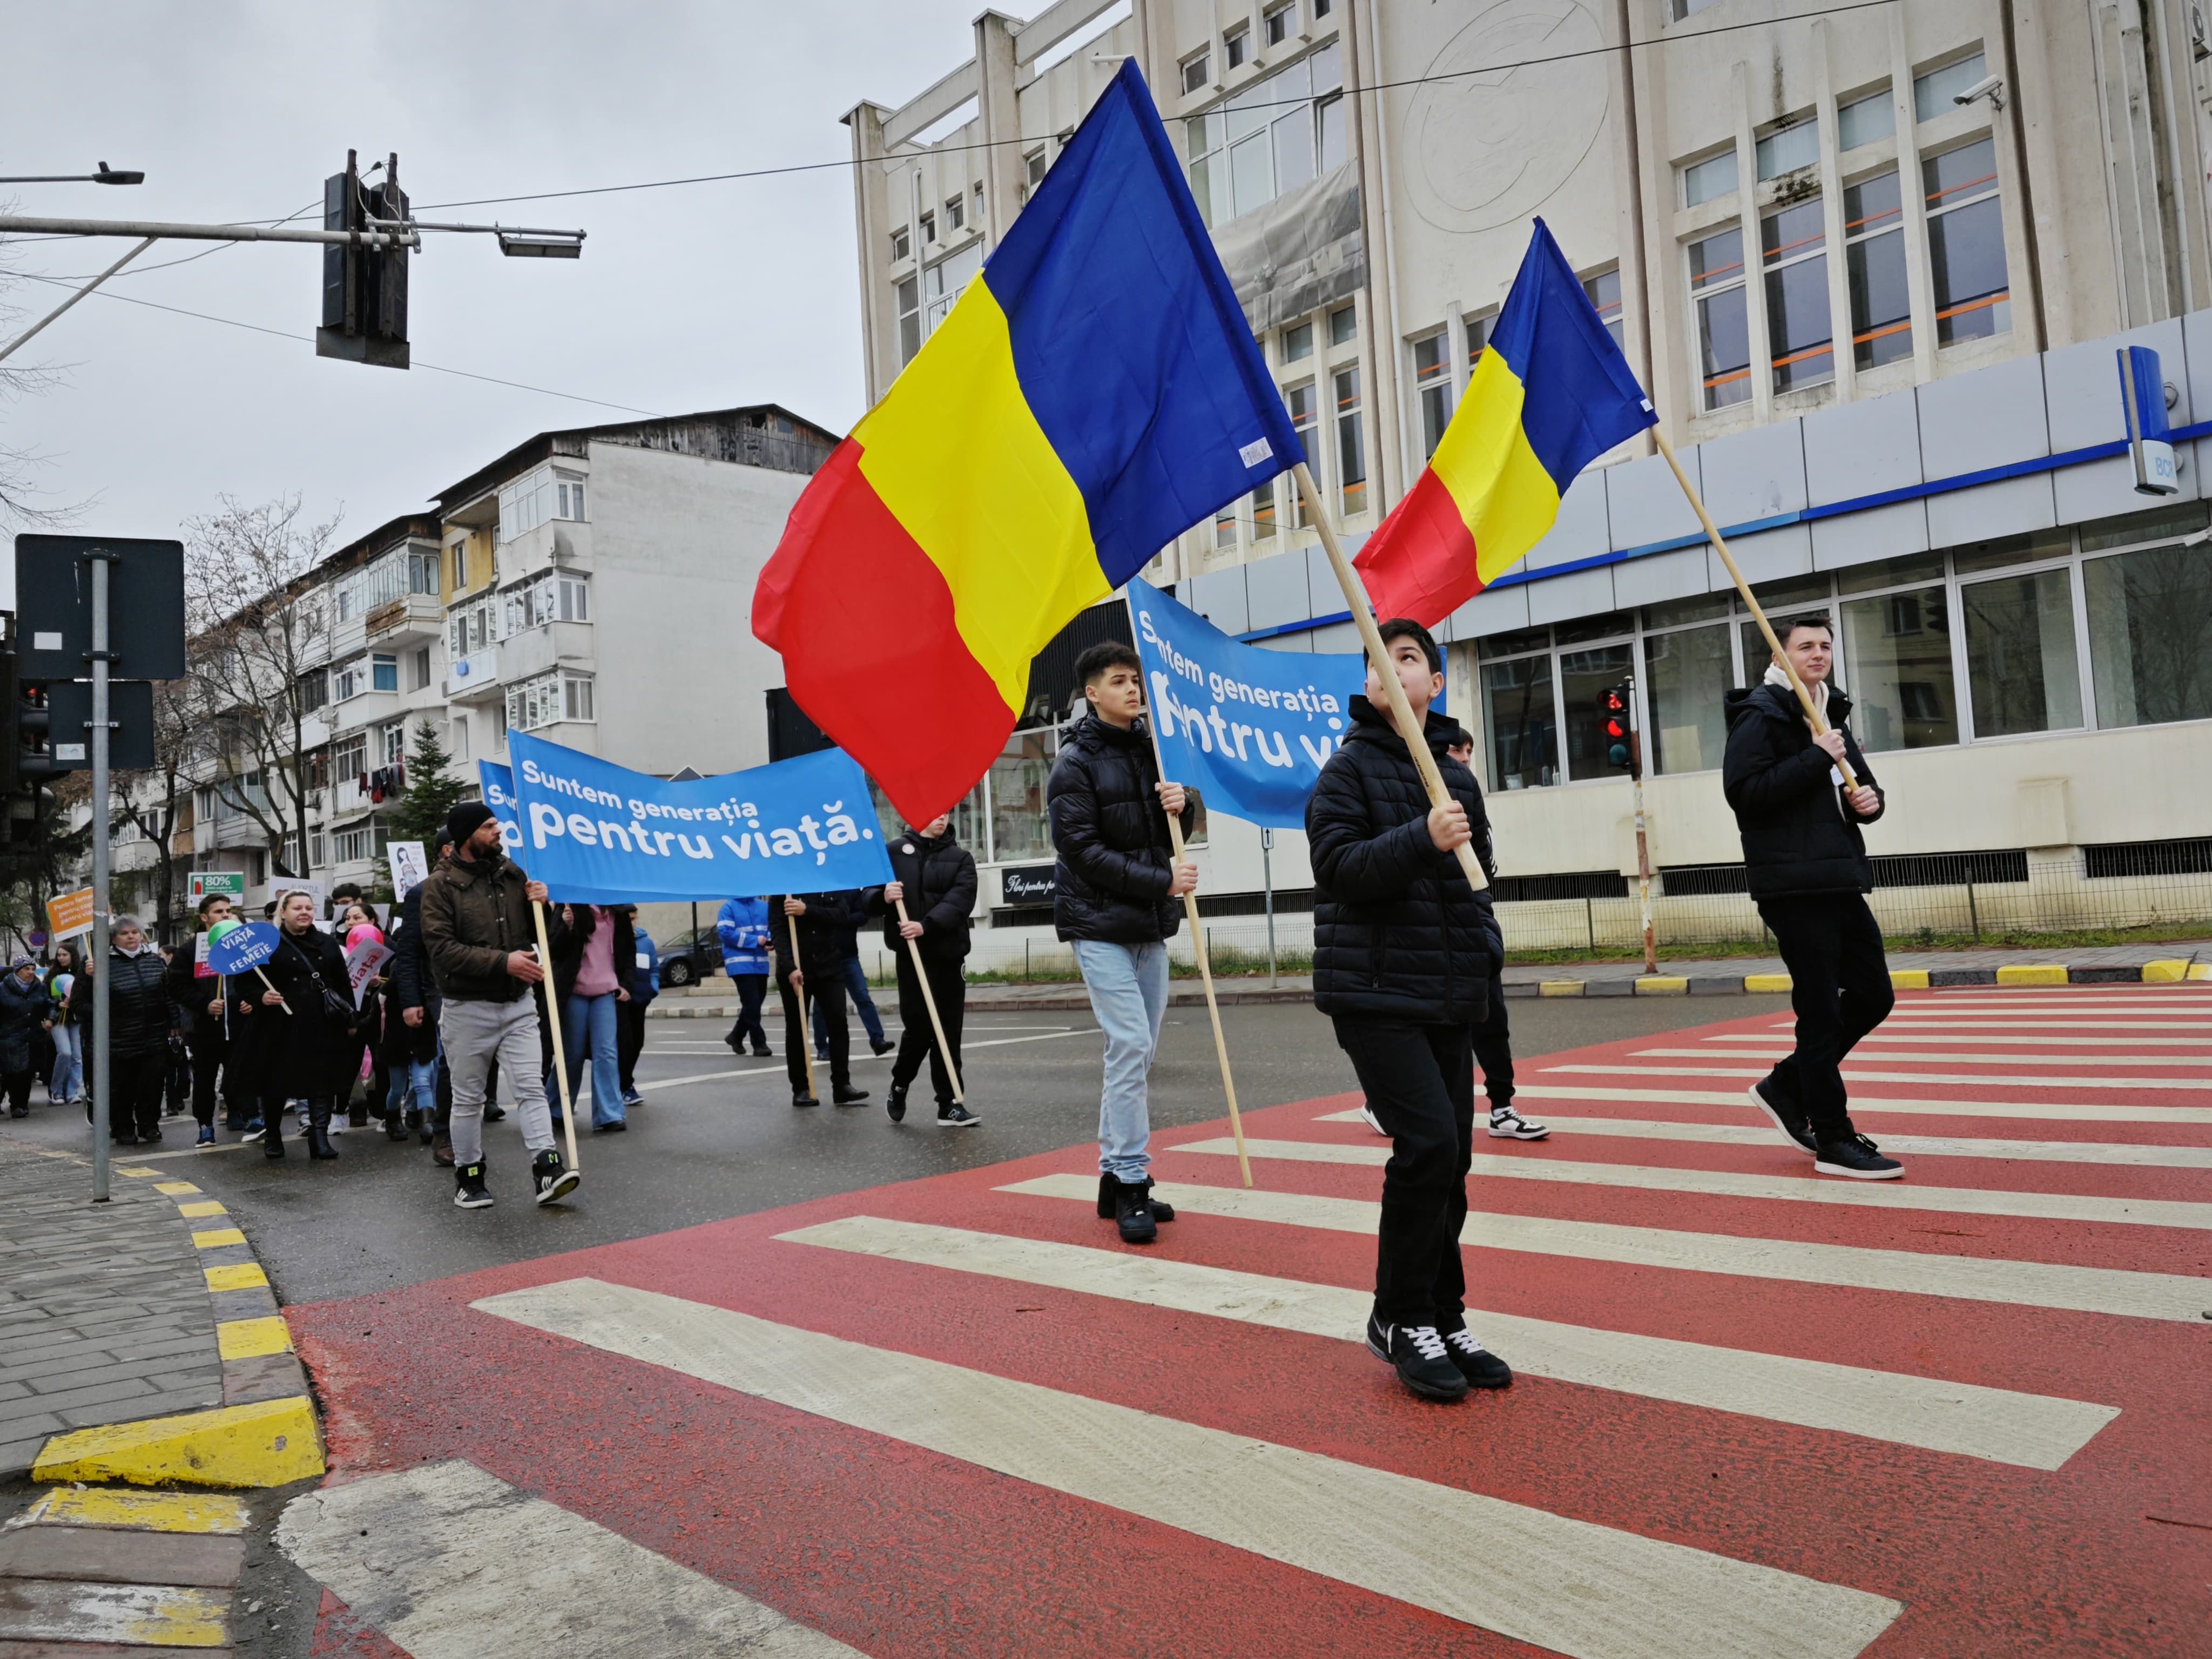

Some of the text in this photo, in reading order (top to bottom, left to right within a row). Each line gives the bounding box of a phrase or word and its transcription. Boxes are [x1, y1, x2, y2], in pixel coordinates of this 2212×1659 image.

[1209, 672, 1339, 721] generația
[522, 760, 758, 827] Suntem generația
[529, 800, 873, 866] pentru viață.
[205, 875, 231, 886] 80%
[221, 929, 240, 942] pentru
[245, 942, 265, 954] pentru
[229, 943, 272, 972] FEMEIE
